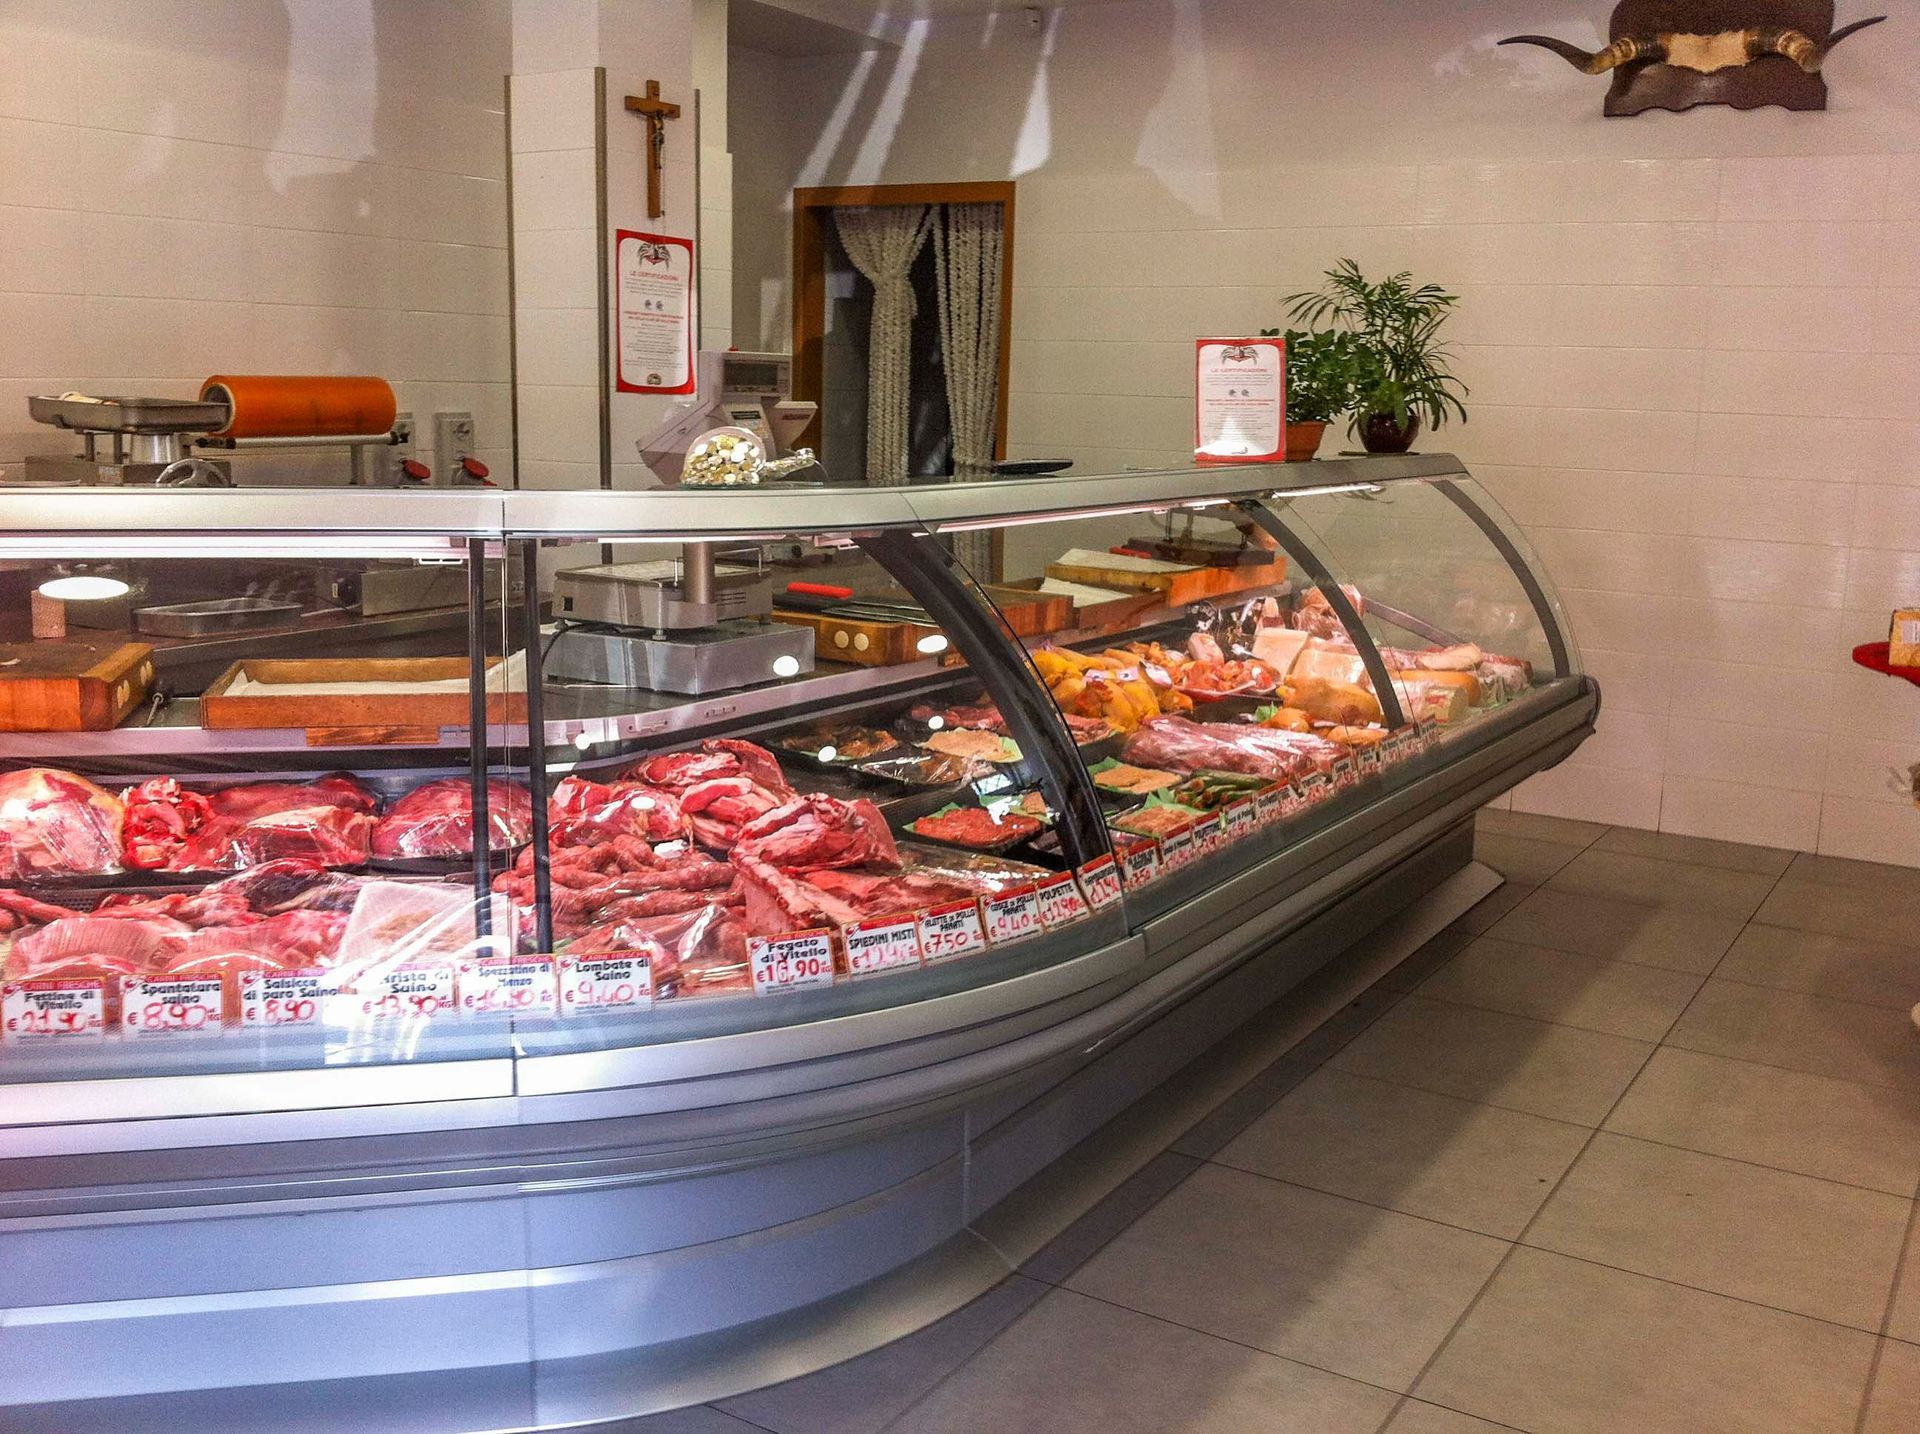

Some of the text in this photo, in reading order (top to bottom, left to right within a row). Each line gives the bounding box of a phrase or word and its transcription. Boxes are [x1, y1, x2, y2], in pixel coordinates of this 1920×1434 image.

[768, 939, 818, 952] Fegato
[848, 928, 915, 950] SPIEDINI MISTI
[760, 948, 827, 963] di Vitello
[478, 963, 550, 977] Spezzatino di
[575, 959, 649, 972] Lombate di
[263, 979, 318, 989] Salsicce
[391, 982, 437, 993] Suino
[24, 991, 94, 1002] Fettine di
[243, 990, 256, 1000] di
